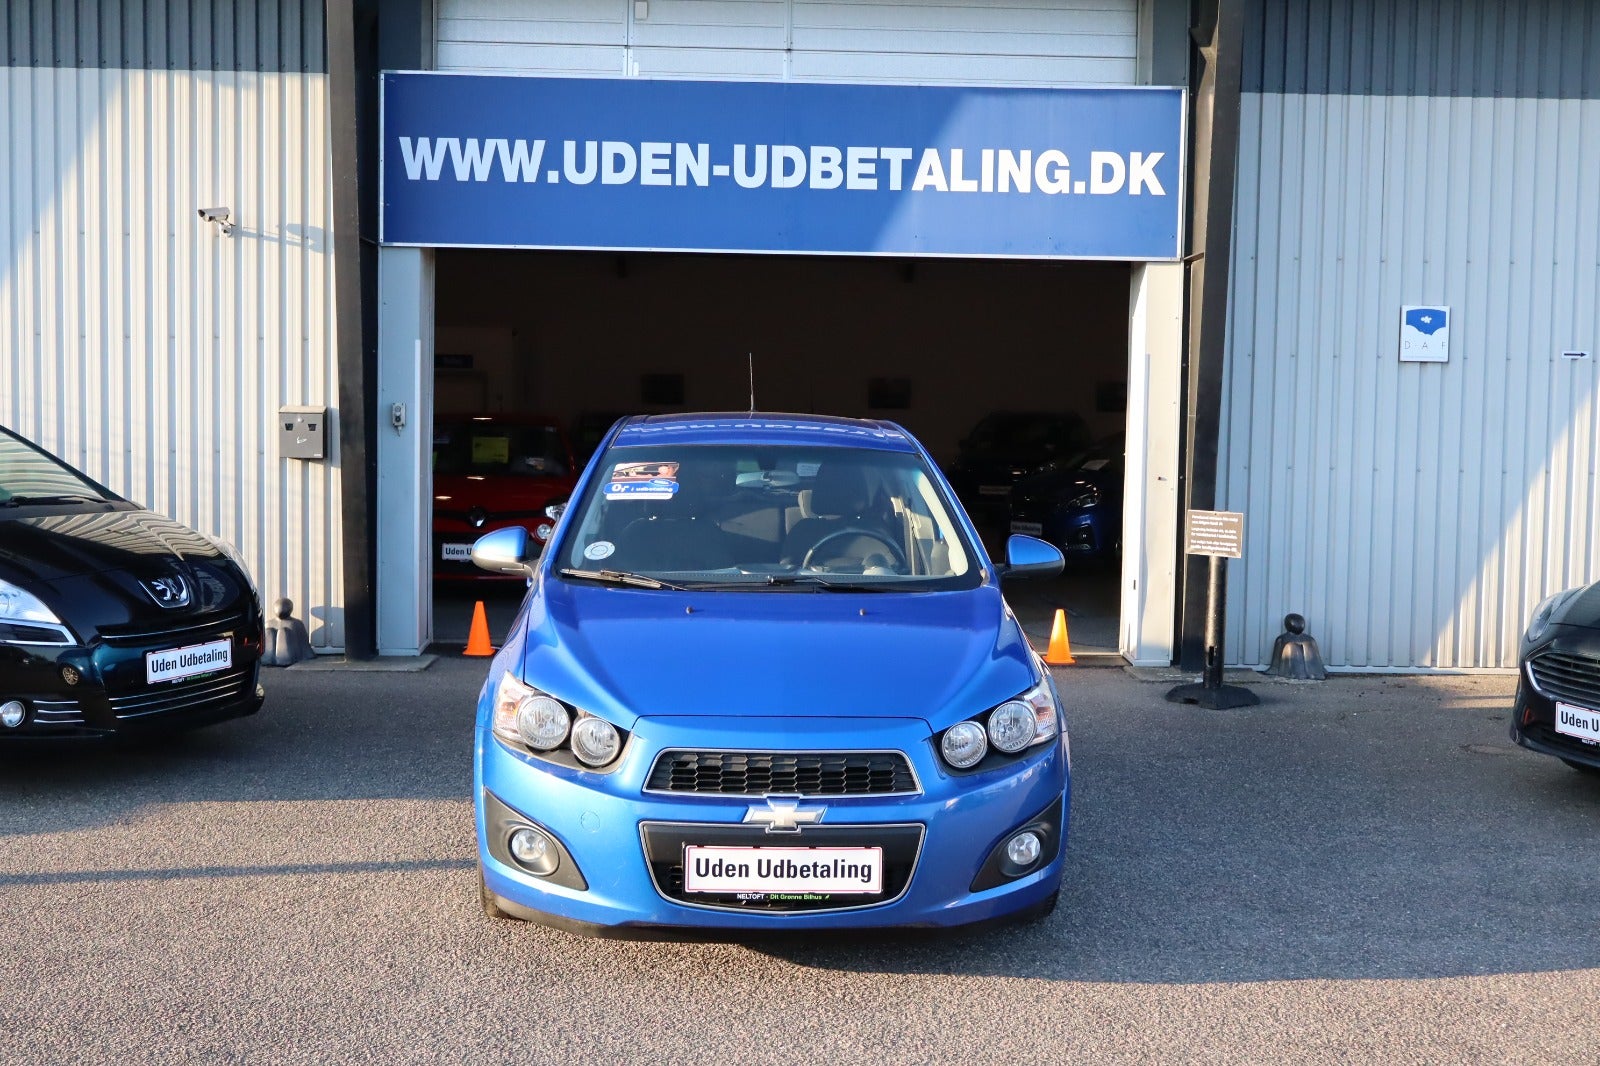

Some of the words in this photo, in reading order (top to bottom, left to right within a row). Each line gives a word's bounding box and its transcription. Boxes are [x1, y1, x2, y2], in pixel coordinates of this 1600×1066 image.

[399, 136, 1166, 196] WWW.UDEN-UDBETALING.DK
[445, 547, 465, 555] Uden
[151, 658, 177, 673] Uden
[180, 649, 228, 667] Udbetaling
[1561, 711, 1588, 729] Uden
[695, 857, 750, 878] Uden
[757, 858, 872, 883] Udbetaling
